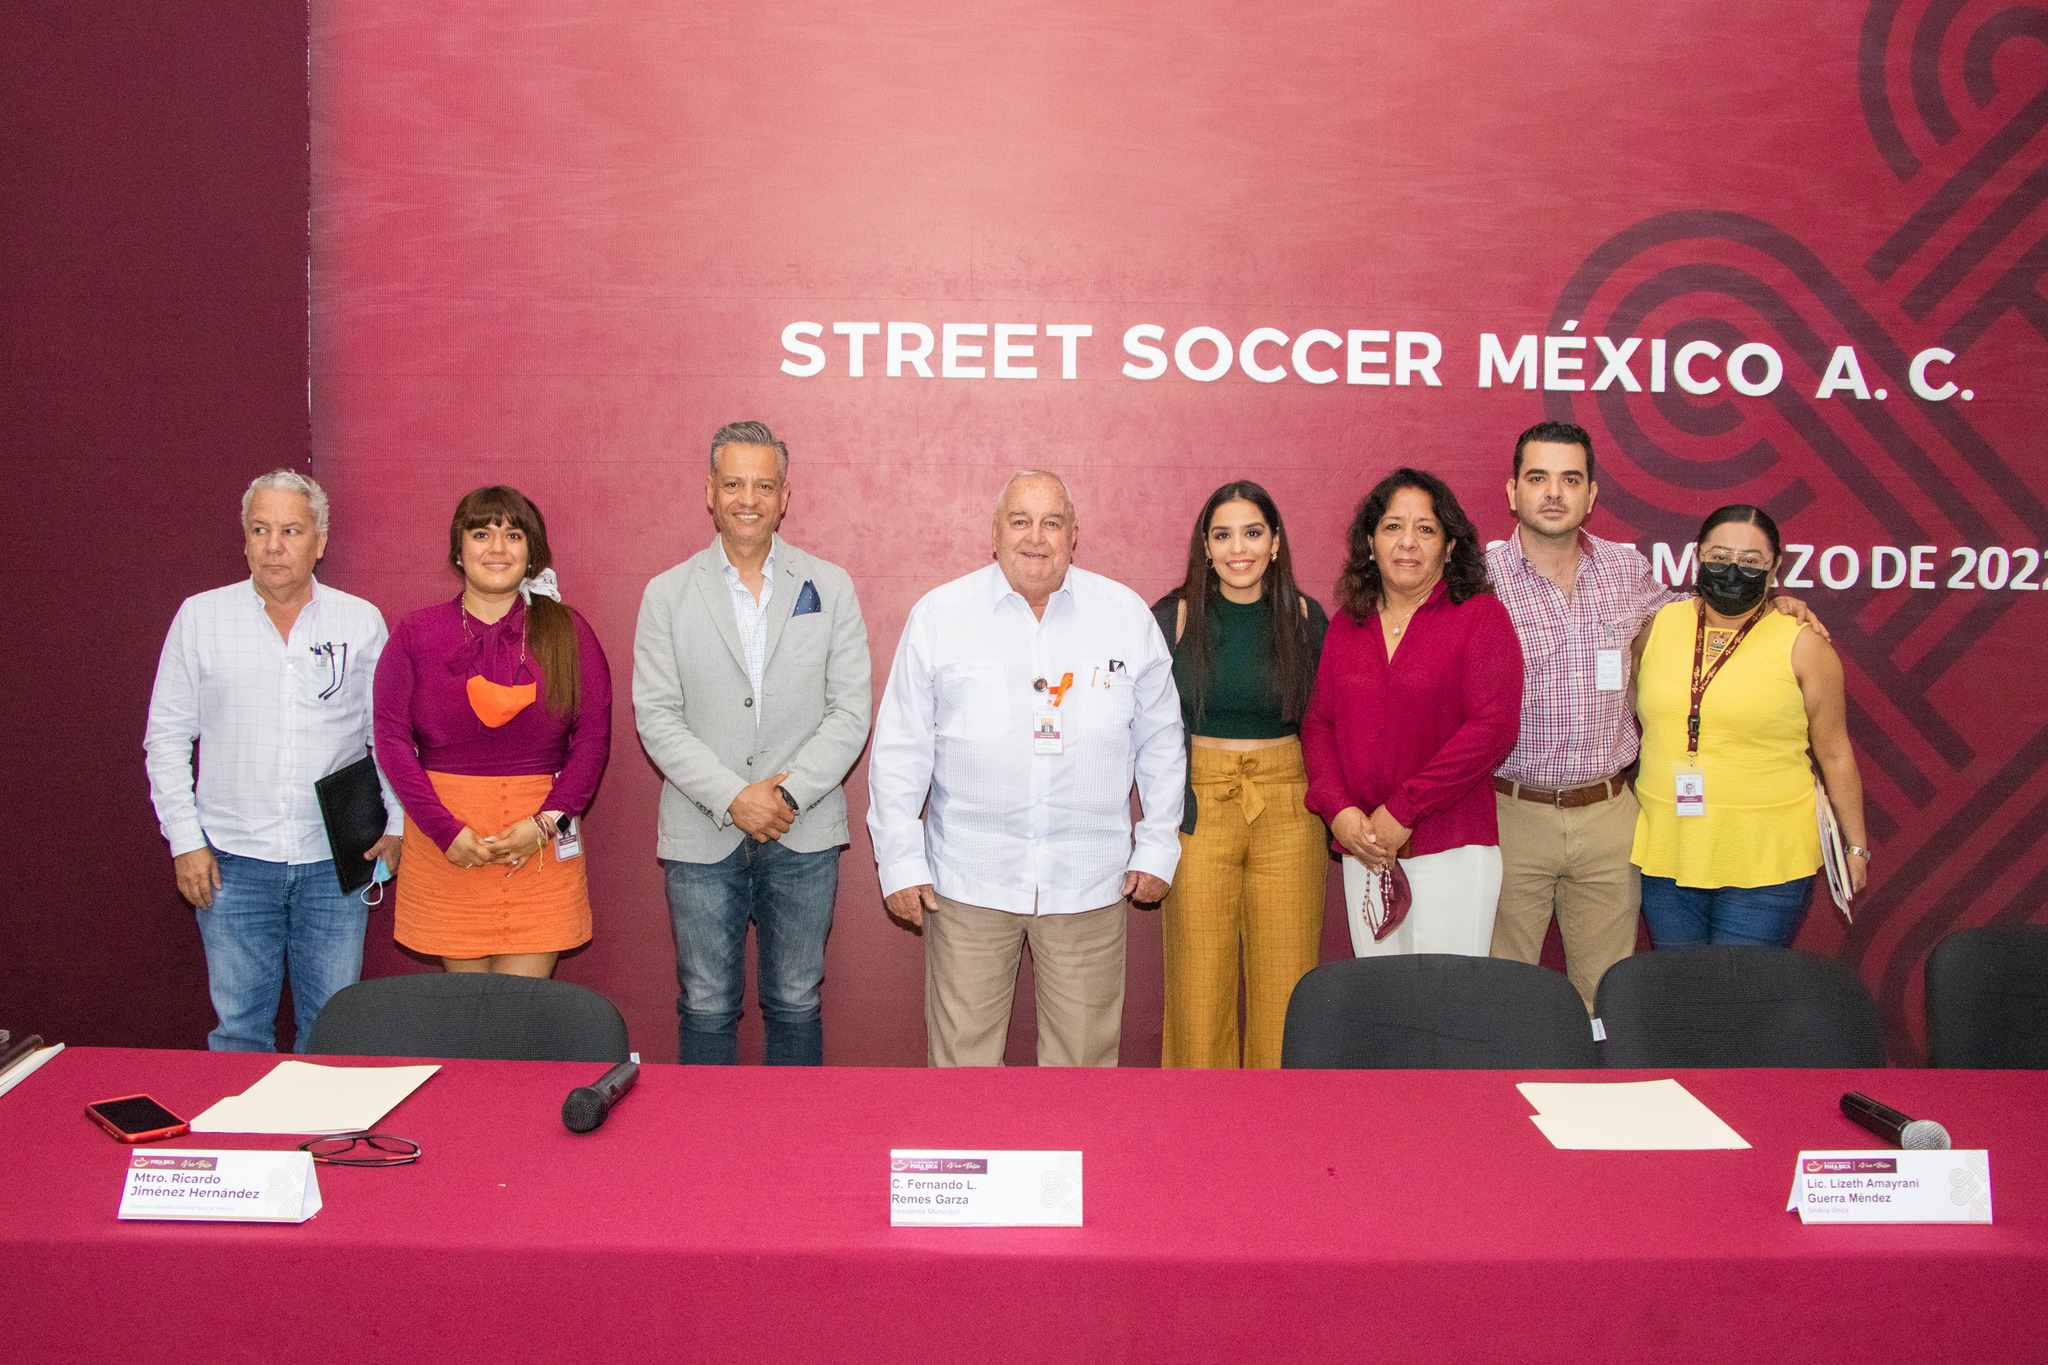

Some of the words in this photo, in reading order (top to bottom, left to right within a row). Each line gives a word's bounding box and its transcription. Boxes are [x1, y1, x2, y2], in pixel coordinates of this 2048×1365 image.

[780, 321, 1093, 379] STREET
[1121, 323, 1443, 386] SOCCER
[1478, 320, 1783, 396] MÉXICO
[1815, 345, 1887, 400] A.
[1908, 347, 1974, 400] C.
[1652, 542, 1860, 591] MZO
[1871, 545, 1938, 590] DE
[1947, 546, 2048, 591] 202
[133, 1172, 167, 1184] Mtro.
[172, 1173, 221, 1185] Ricardo
[891, 1178, 904, 1189] C.
[907, 1179, 963, 1190] Fernando
[966, 1180, 977, 1190] L.
[1807, 1178, 1827, 1189] Lic.
[1830, 1178, 1863, 1189] Lizeth
[1866, 1178, 1920, 1191] Amayrani
[130, 1186, 186, 1198] Jiménez
[189, 1187, 260, 1200] Hernández
[891, 1194, 931, 1205] Remes
[935, 1194, 969, 1205] Garza
[1807, 1193, 1846, 1204] Guerra
[1849, 1192, 1891, 1203] Méndez
[891, 1207, 926, 1215] Presidente
[927, 1208, 960, 1216] Municipal
